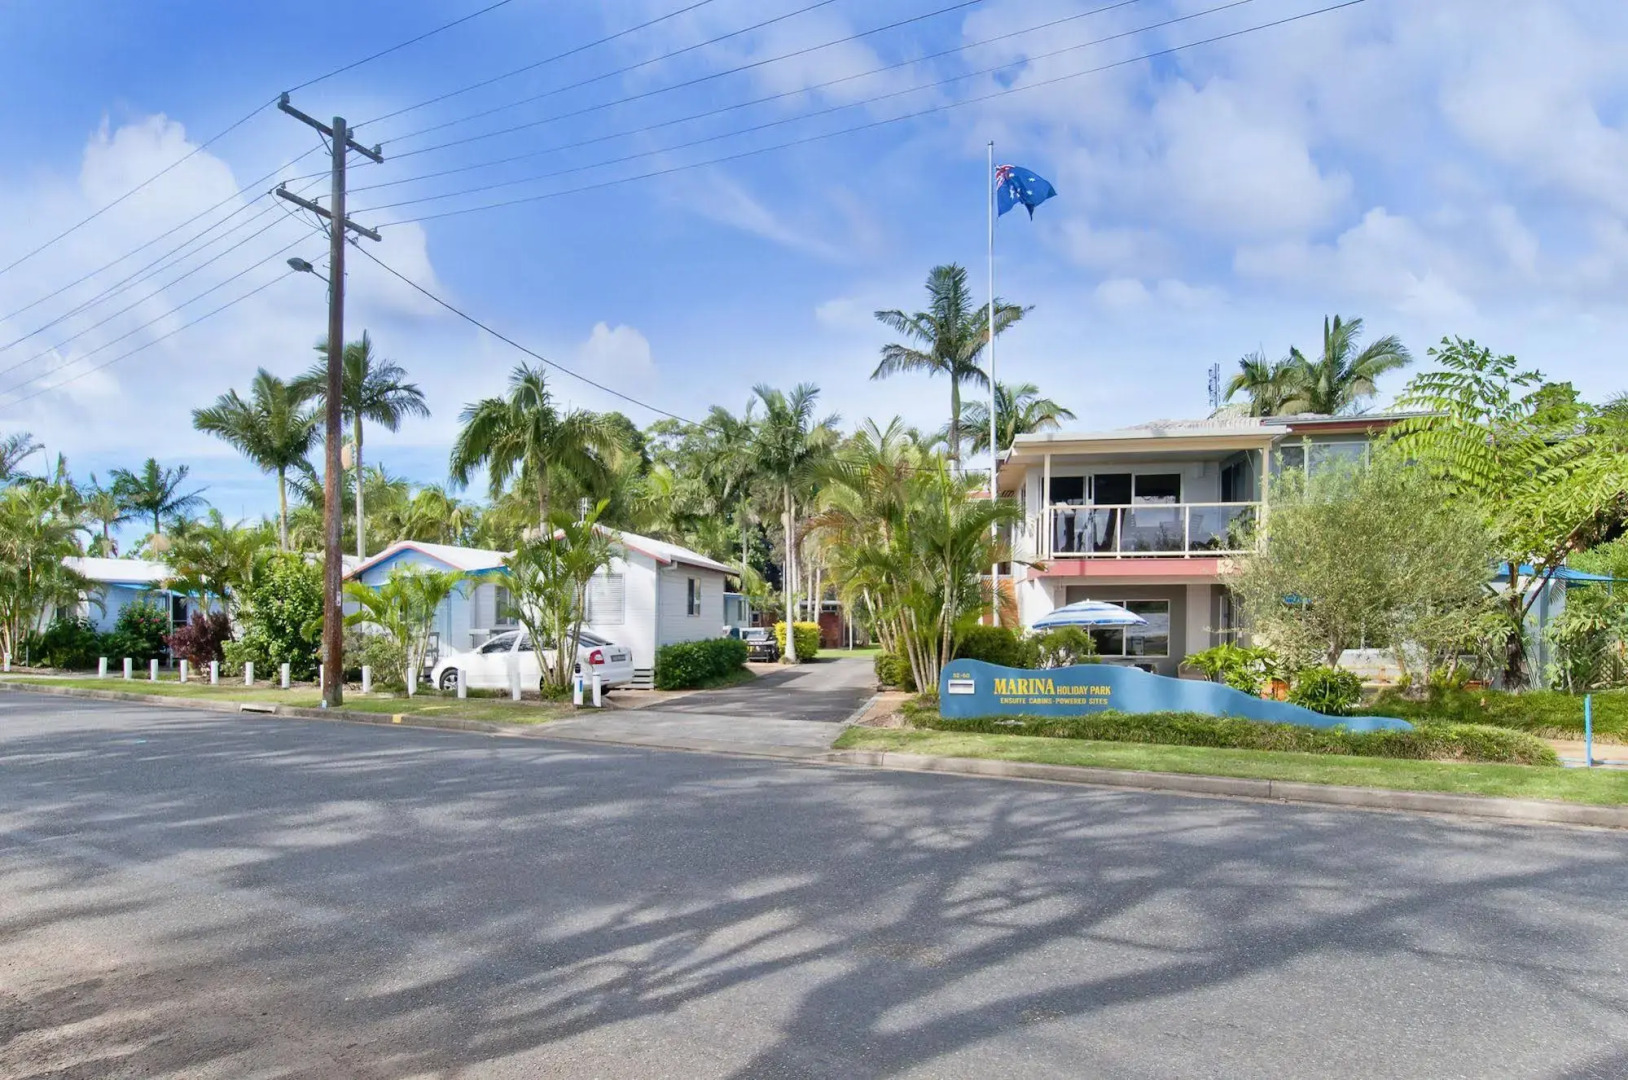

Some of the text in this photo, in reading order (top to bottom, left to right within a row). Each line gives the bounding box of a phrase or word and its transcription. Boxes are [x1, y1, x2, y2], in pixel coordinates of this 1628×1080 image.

[994, 678, 1111, 695] MARINA HOLIDAY PARK
